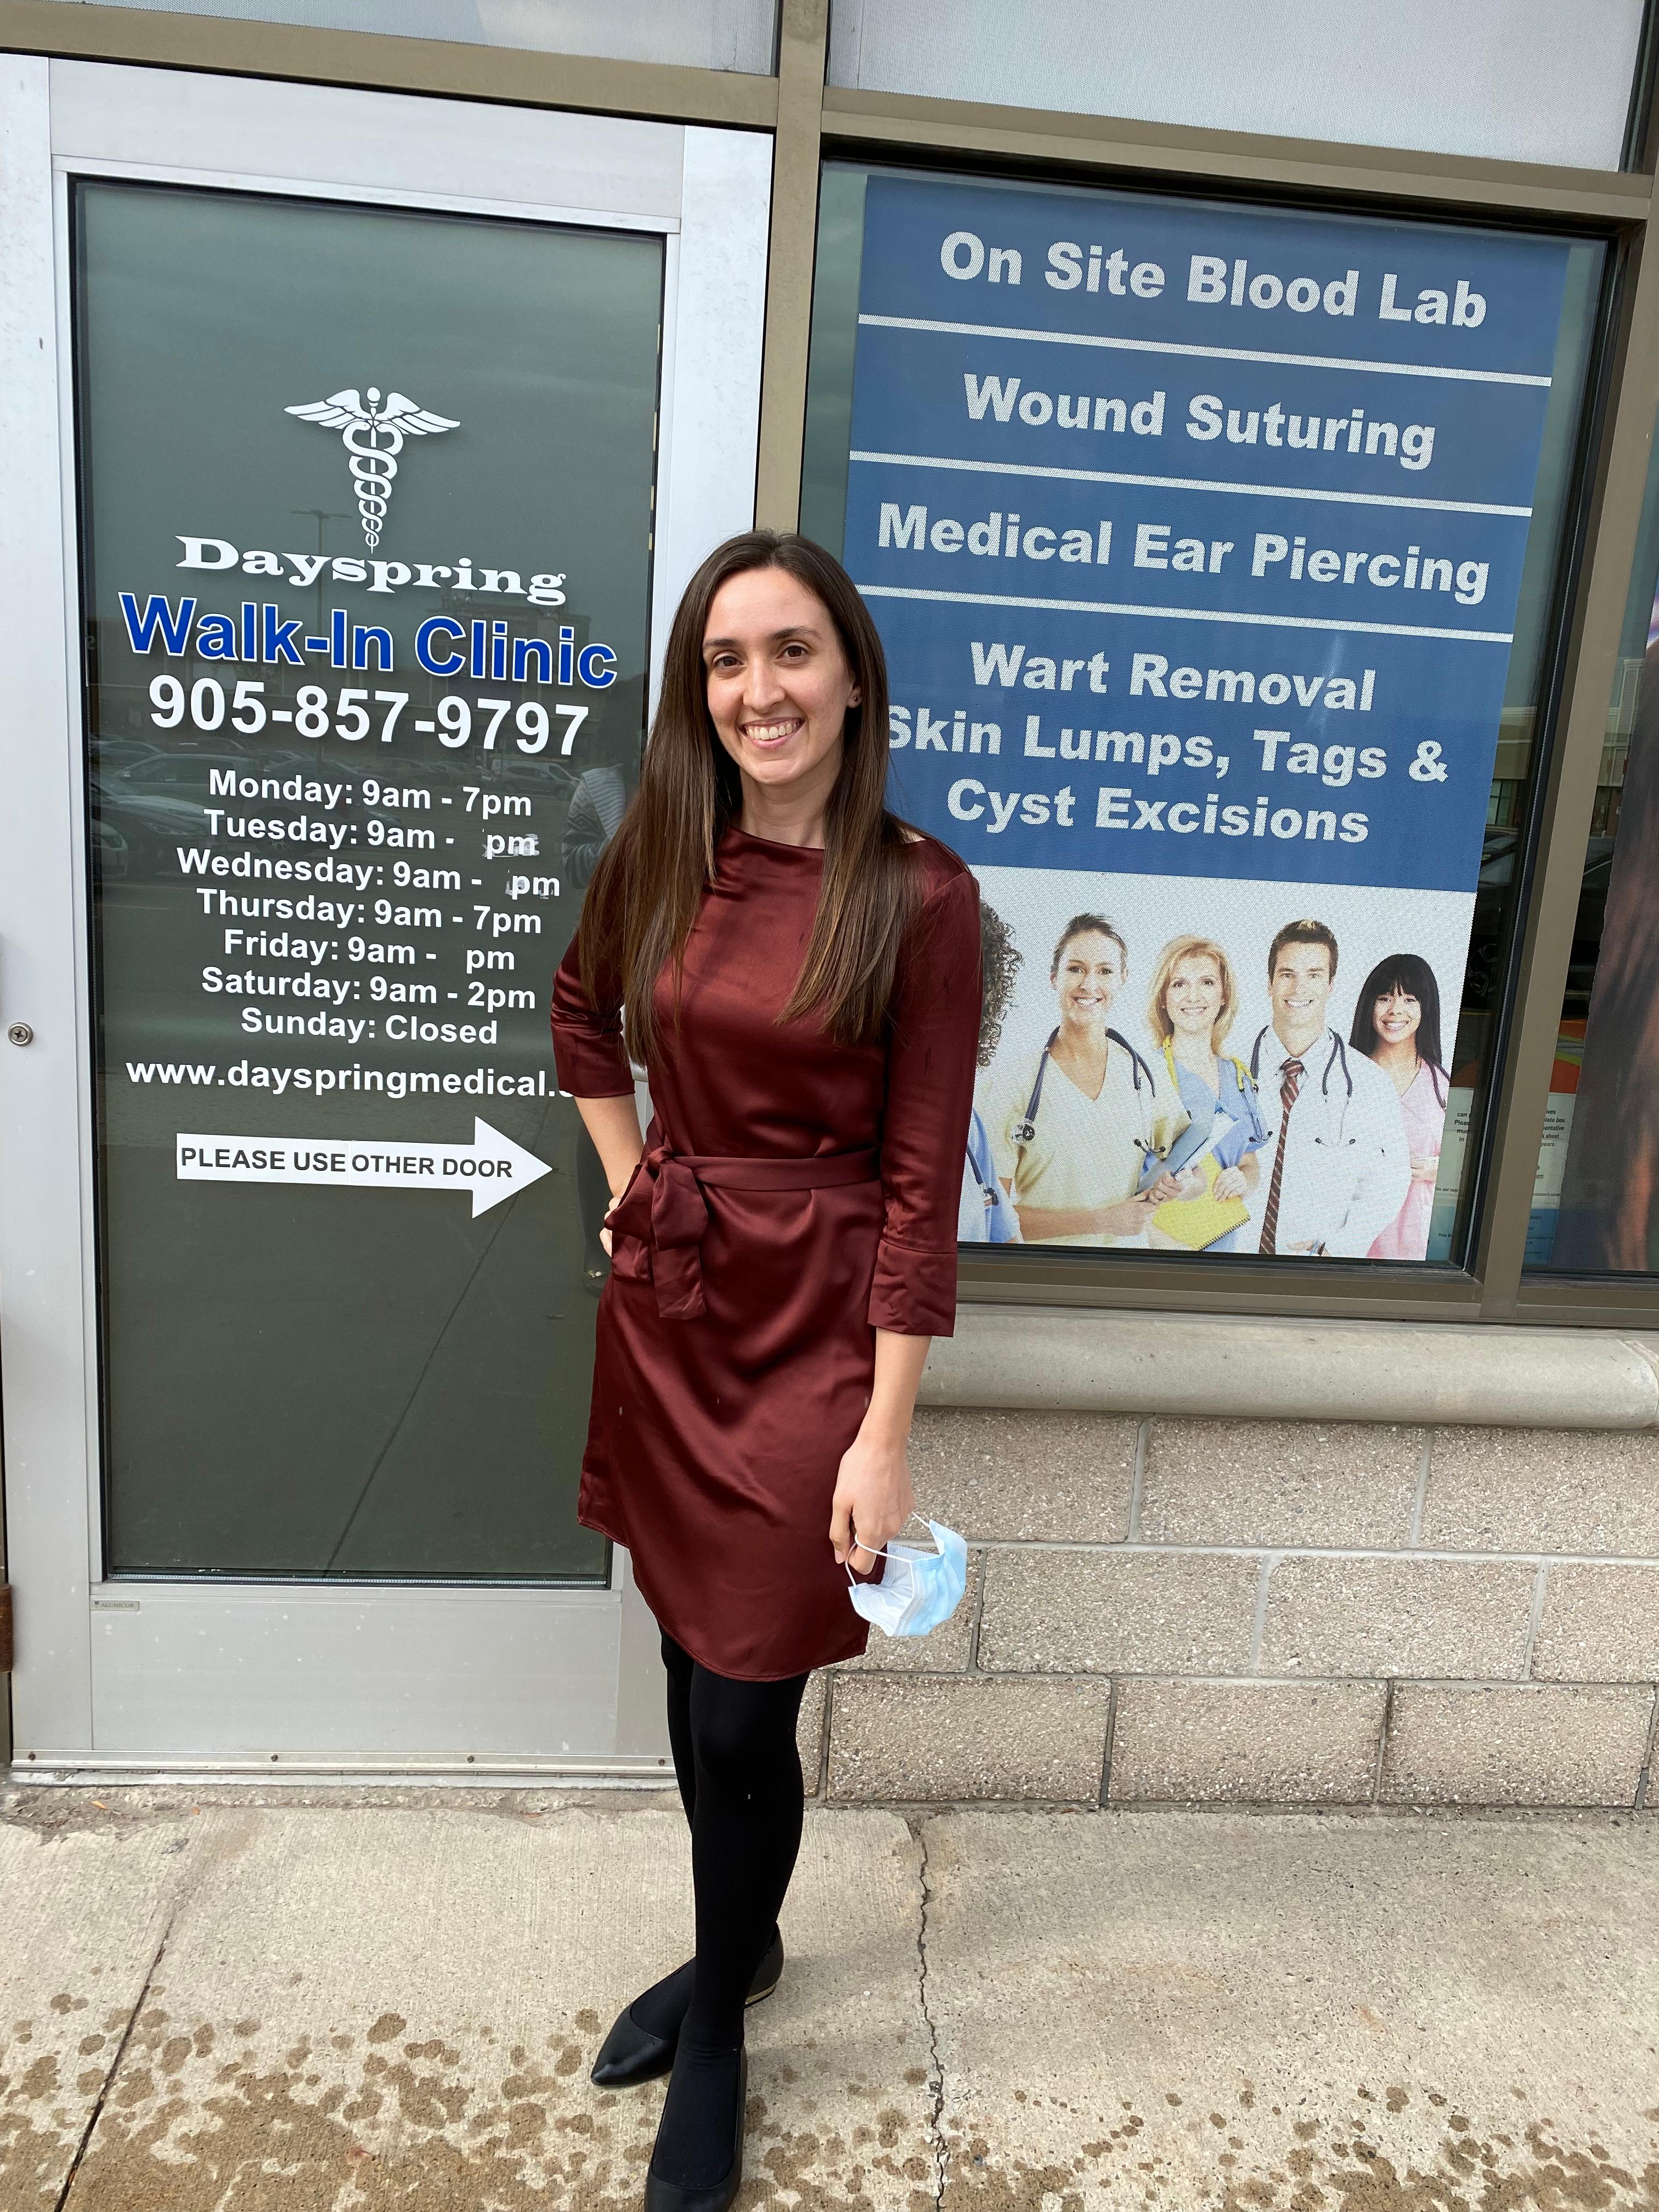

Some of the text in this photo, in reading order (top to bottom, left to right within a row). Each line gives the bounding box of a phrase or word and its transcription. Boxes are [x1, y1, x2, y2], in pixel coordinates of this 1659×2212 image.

[940, 231, 1487, 328] On Site Blood Lab
[963, 373, 1436, 471] Wound Suturing
[175, 535, 567, 606] Dayspring
[878, 502, 1489, 605] Medical Ear Piercing
[118, 591, 618, 689] Walk-In Clinic
[970, 641, 1376, 711] Wart Removal
[149, 674, 589, 755] 905-857-9797
[888, 704, 1449, 787] Skin Lumps, Tags &
[210, 769, 352, 810] Monday:
[362, 779, 431, 809] 9am
[462, 786, 531, 820] 7pm
[947, 778, 1369, 843] Cyst Excisions
[203, 809, 357, 850] Tuesday:
[367, 820, 435, 849] 9am
[487, 834, 535, 860] pm
[176, 847, 383, 891] Wednesday:
[393, 861, 460, 890] 9am
[512, 875, 560, 900] pm
[196, 888, 364, 929] Thursday:
[374, 899, 442, 928] 9am
[473, 905, 541, 938] 7pm
[225, 929, 338, 966] Friday:
[348, 936, 415, 964] 9am
[466, 950, 515, 974] pm
[201, 966, 360, 1005] Saturday:
[370, 975, 437, 1003] 9am
[467, 981, 535, 1013] 2pm
[241, 1007, 497, 1044] Sunday: Closed
[182, 1148, 512, 1178] PLEASE USE OTHER DOOR
